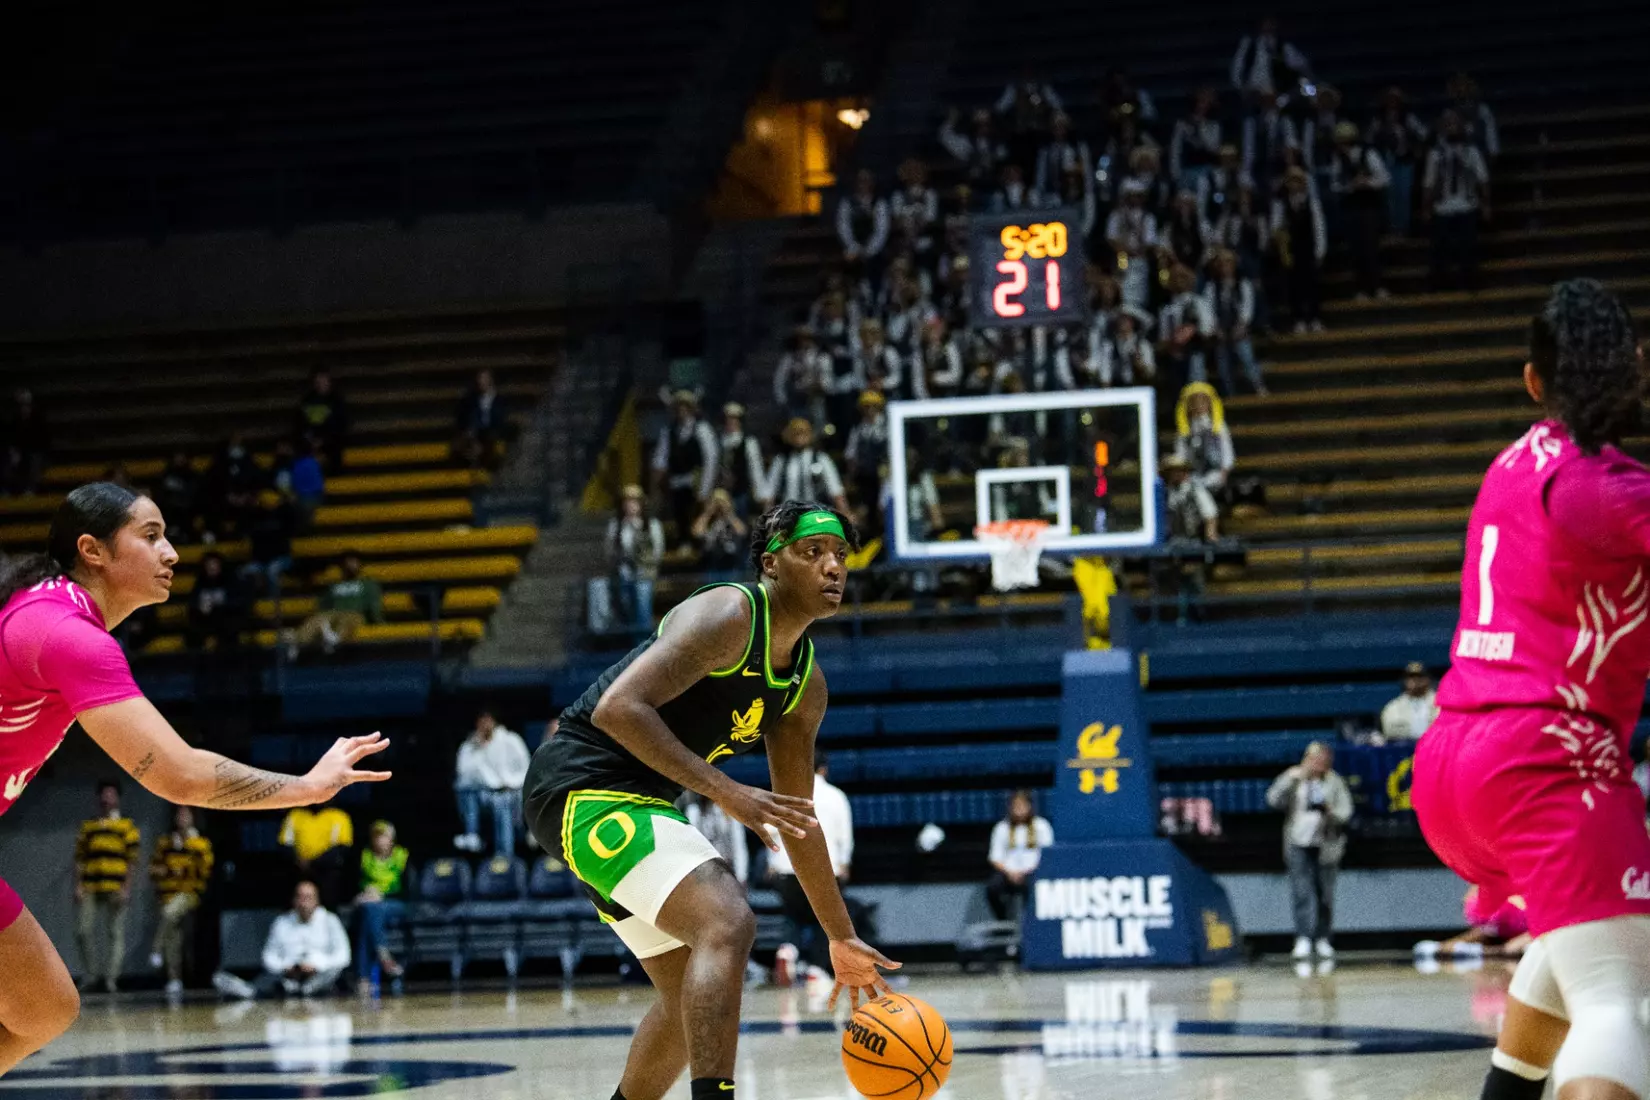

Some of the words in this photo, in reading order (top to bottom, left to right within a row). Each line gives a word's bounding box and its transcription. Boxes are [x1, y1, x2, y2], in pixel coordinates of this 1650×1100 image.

[1001, 221, 1068, 260] 5:20
[992, 259, 1061, 317] 21
[1477, 524, 1499, 625] 1
[1035, 875, 1173, 920] MUSCLE
[1061, 917, 1150, 958] MILK
[845, 1019, 888, 1057] Wilso
